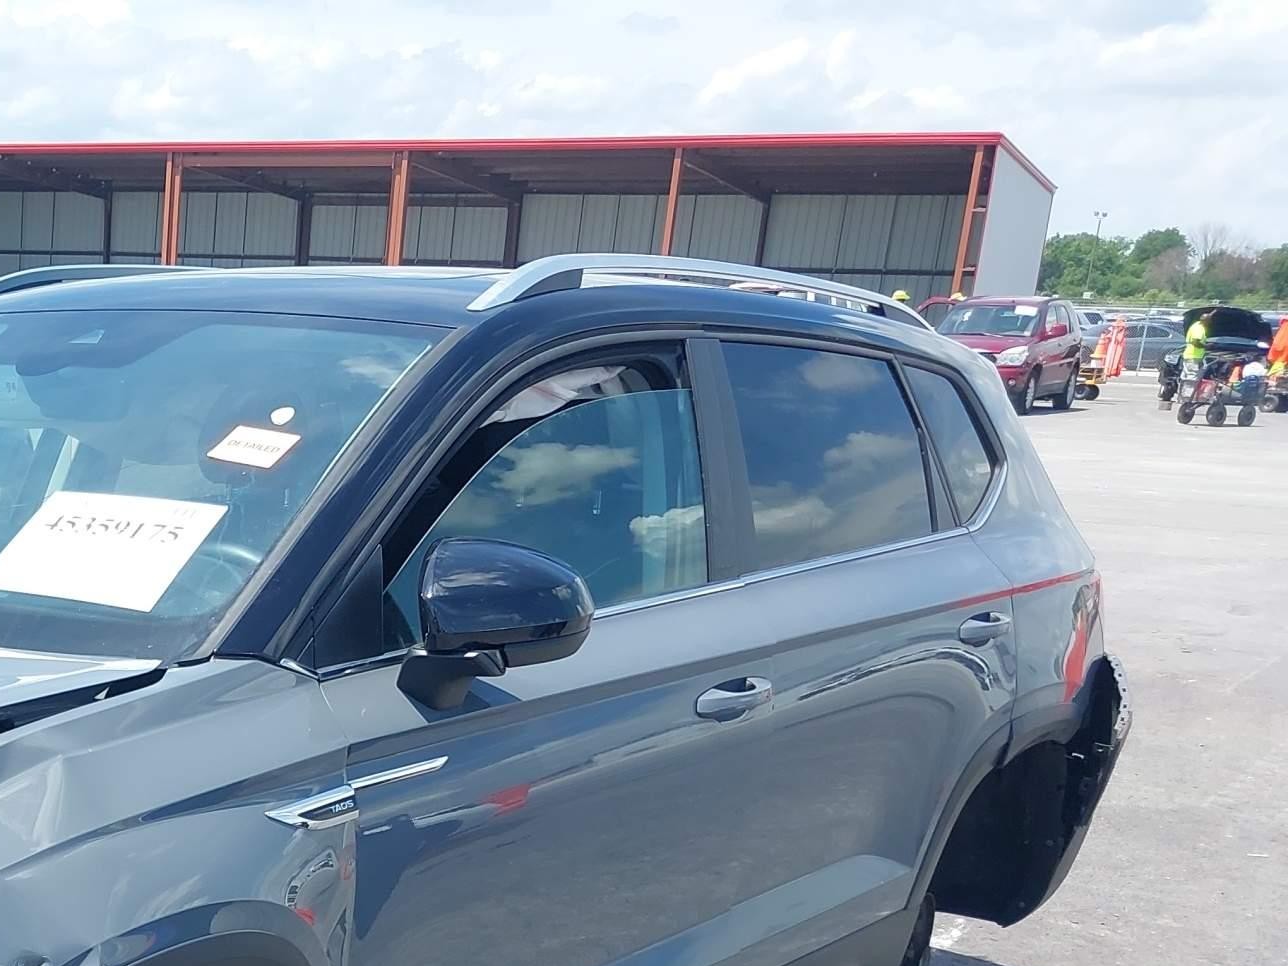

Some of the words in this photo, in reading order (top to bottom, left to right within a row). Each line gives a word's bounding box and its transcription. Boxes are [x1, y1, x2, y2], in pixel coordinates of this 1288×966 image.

[227, 440, 281, 453] DETAILED
[45, 515, 185, 543] 45359175
[329, 799, 354, 813] TAOS
